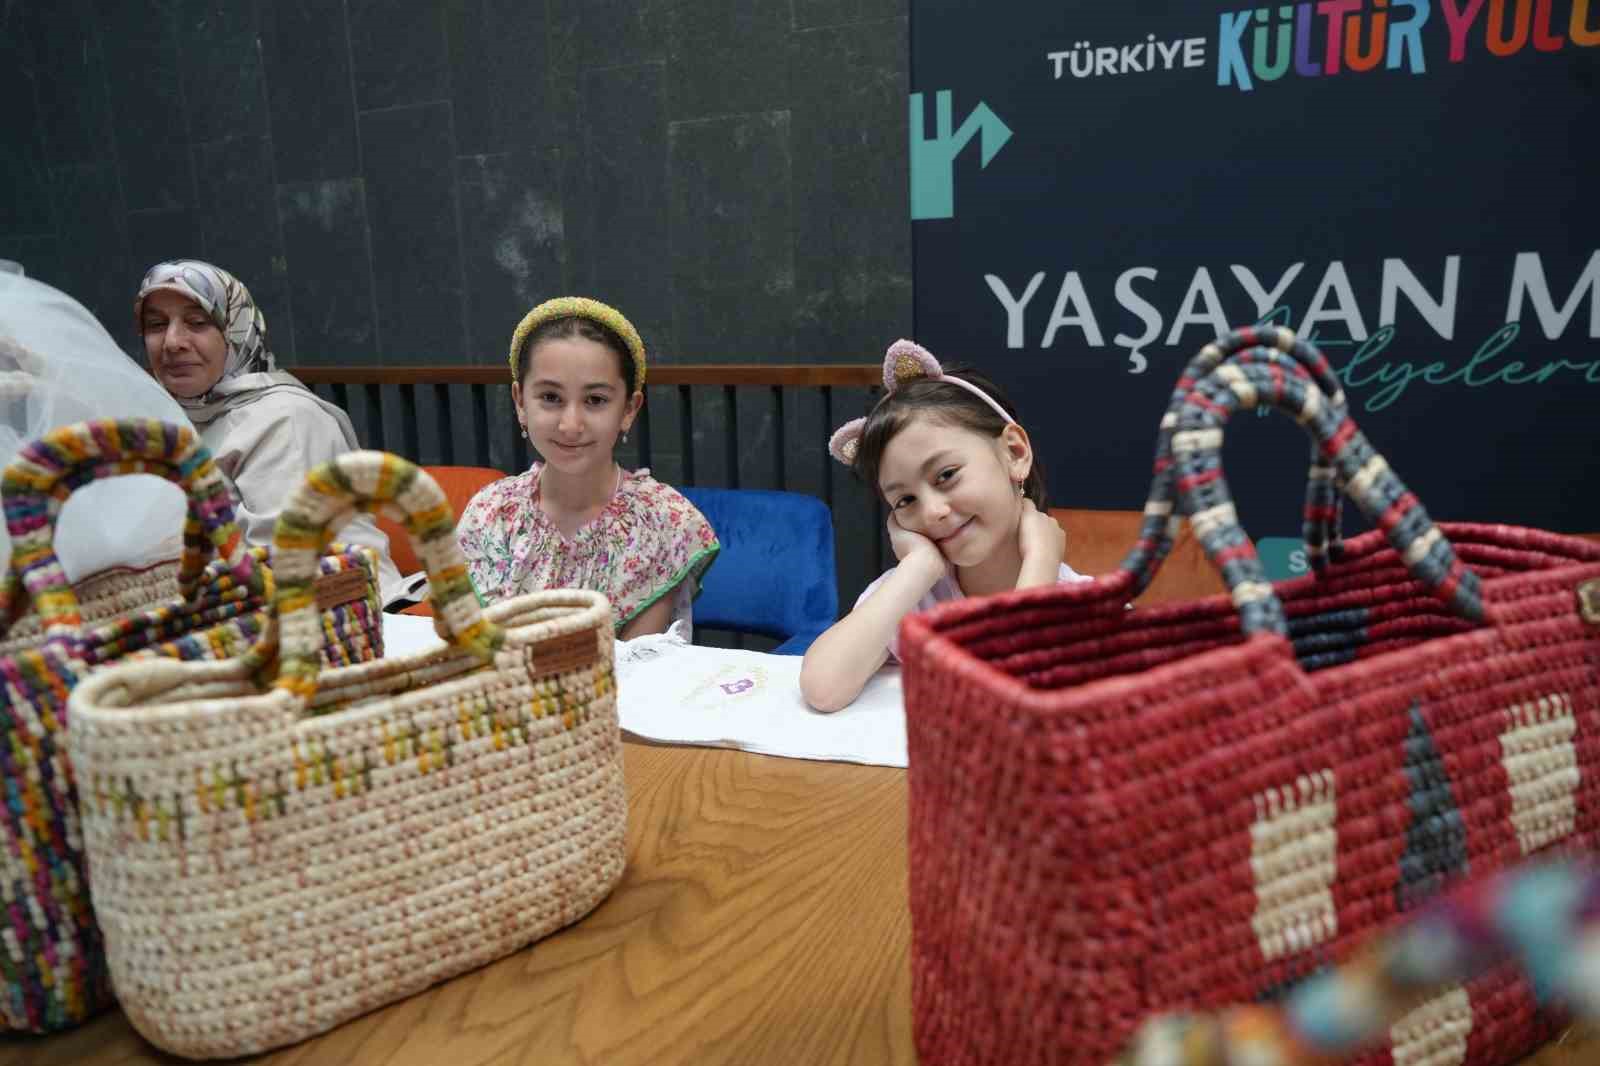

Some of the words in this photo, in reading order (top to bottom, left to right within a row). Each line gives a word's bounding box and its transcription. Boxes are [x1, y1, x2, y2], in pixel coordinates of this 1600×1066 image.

[1047, 33, 1206, 80] TÜRKİYE
[1217, 0, 1431, 91] KÜLTÜR
[984, 256, 1460, 374] YAŞAYAN
